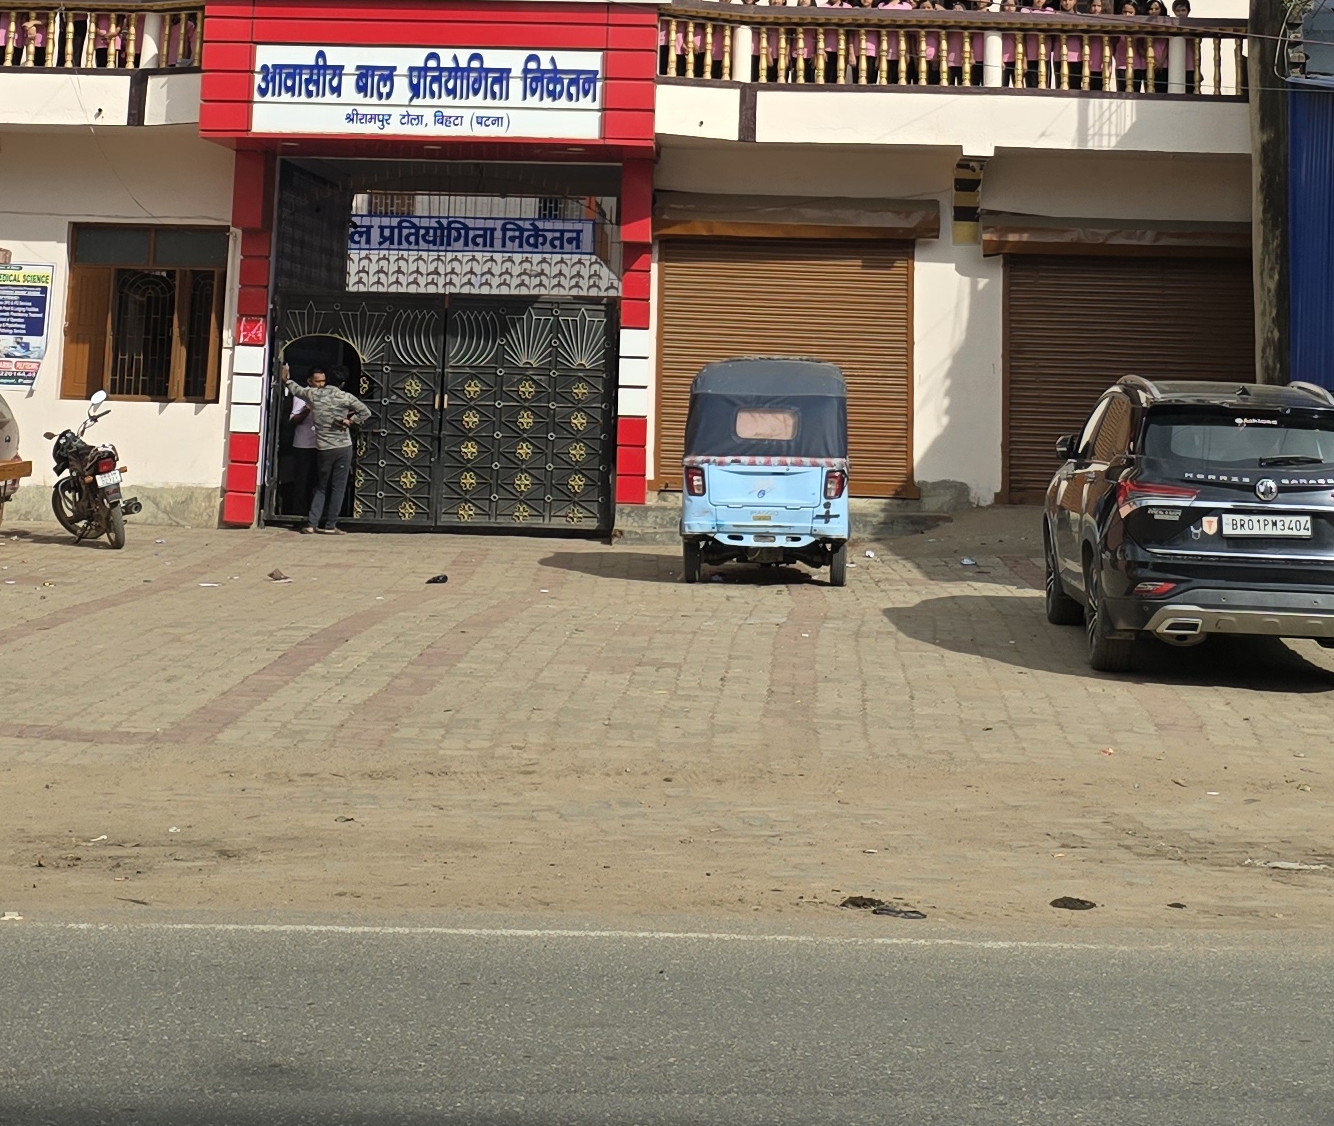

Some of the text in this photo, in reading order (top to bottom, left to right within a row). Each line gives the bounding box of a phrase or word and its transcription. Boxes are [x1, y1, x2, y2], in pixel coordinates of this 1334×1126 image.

[256, 49, 599, 106] आवासीय बाल प्रतियोगिता निकेतन
[344, 108, 510, 133] श्रीरामपुर टोला, बिहटा (पटना)
[378, 219, 496, 248] प्रतियोगिता
[501, 221, 583, 250] निकेतन
[23, 274, 50, 284] SCIENCE
[1231, 518, 1310, 532] BR01PM3404
